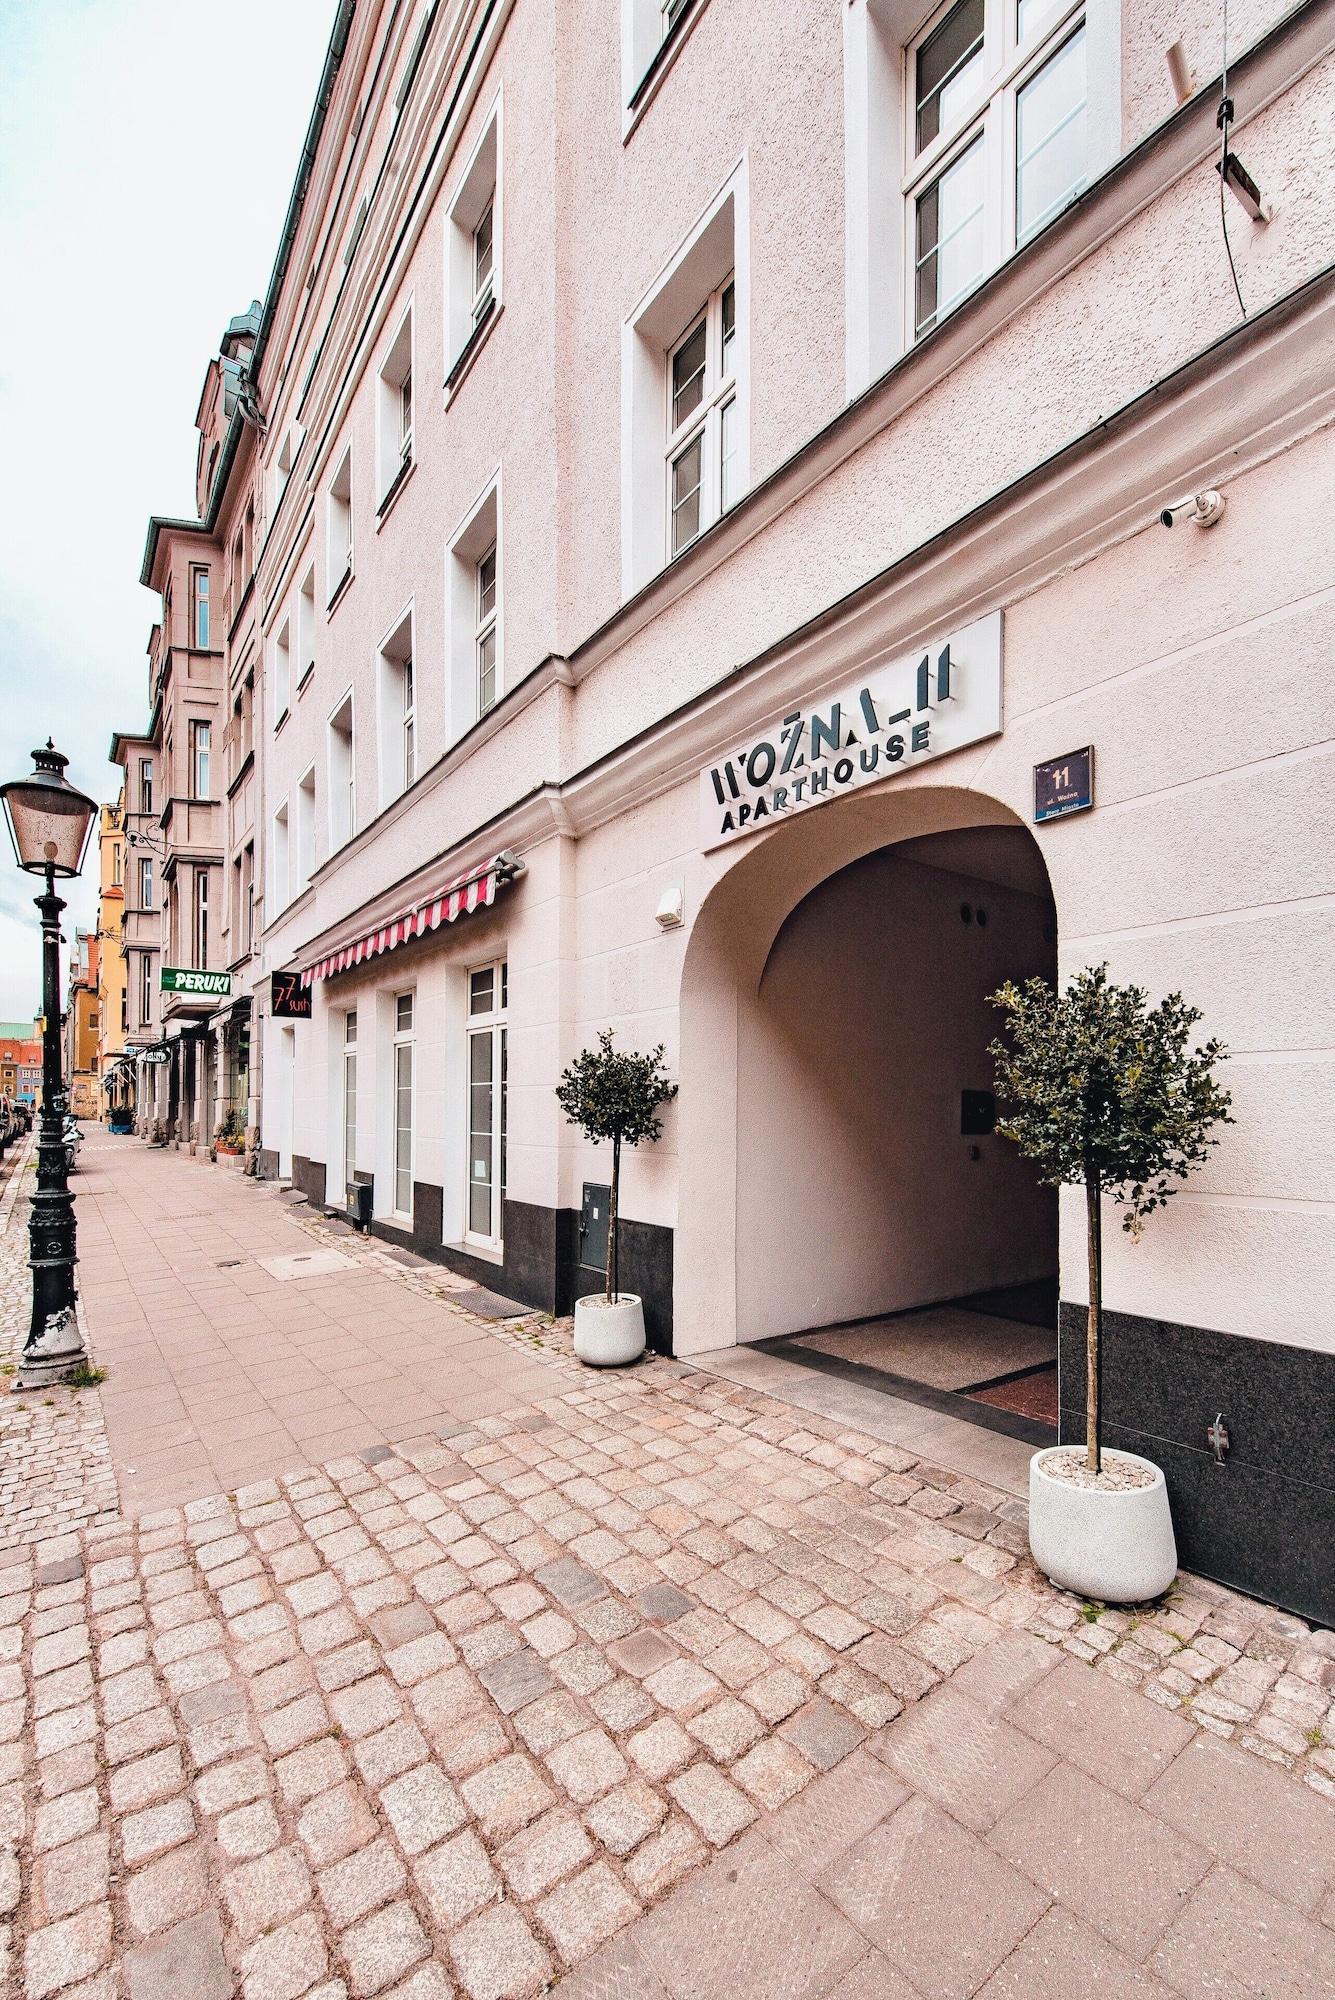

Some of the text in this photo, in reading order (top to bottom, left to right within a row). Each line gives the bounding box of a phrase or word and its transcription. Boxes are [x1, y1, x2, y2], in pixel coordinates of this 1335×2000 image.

[720, 720, 930, 834] APARTHOUSE
[1052, 766, 1070, 790] 11
[174, 972, 230, 993] PERUKI
